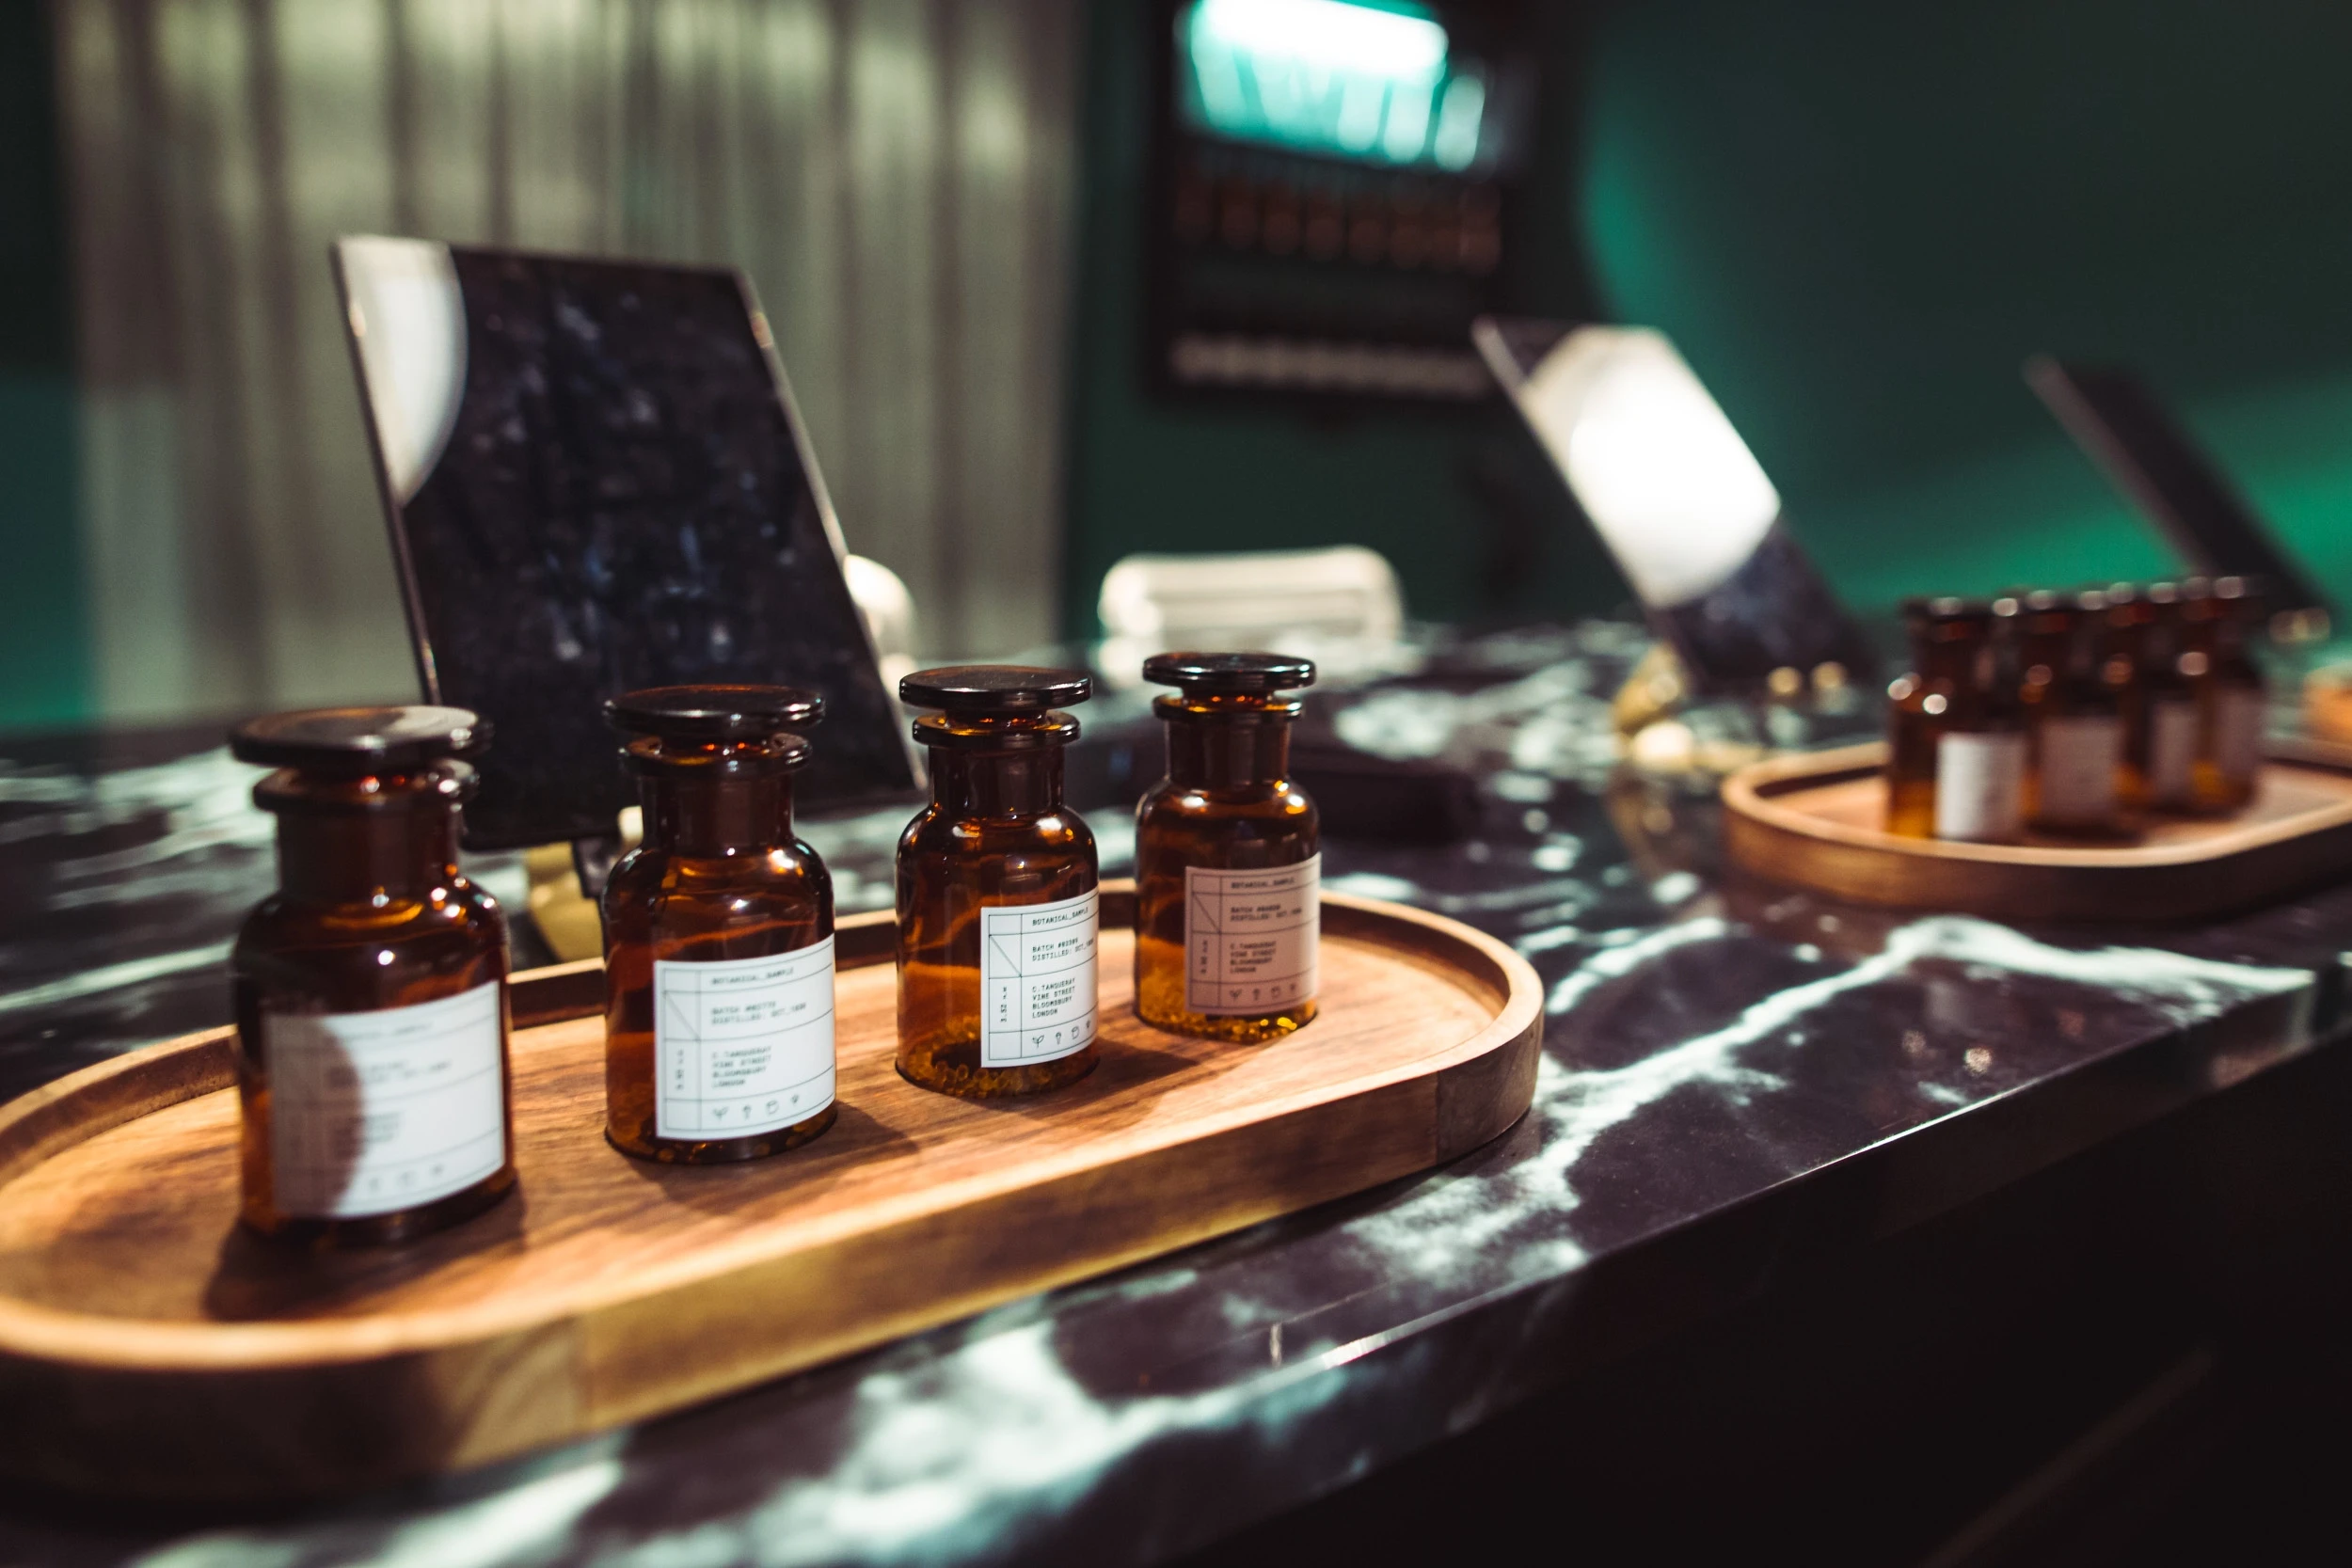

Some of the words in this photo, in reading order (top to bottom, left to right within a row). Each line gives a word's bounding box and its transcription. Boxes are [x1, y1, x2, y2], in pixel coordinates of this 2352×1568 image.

[1032, 943, 1055, 953] BATCH
[1032, 992, 1050, 1001] VINE
[1054, 987, 1075, 998] STREET
[1032, 996, 1073, 1009] BLOOMSBURY
[1032, 1008, 1058, 1019] LONDON
